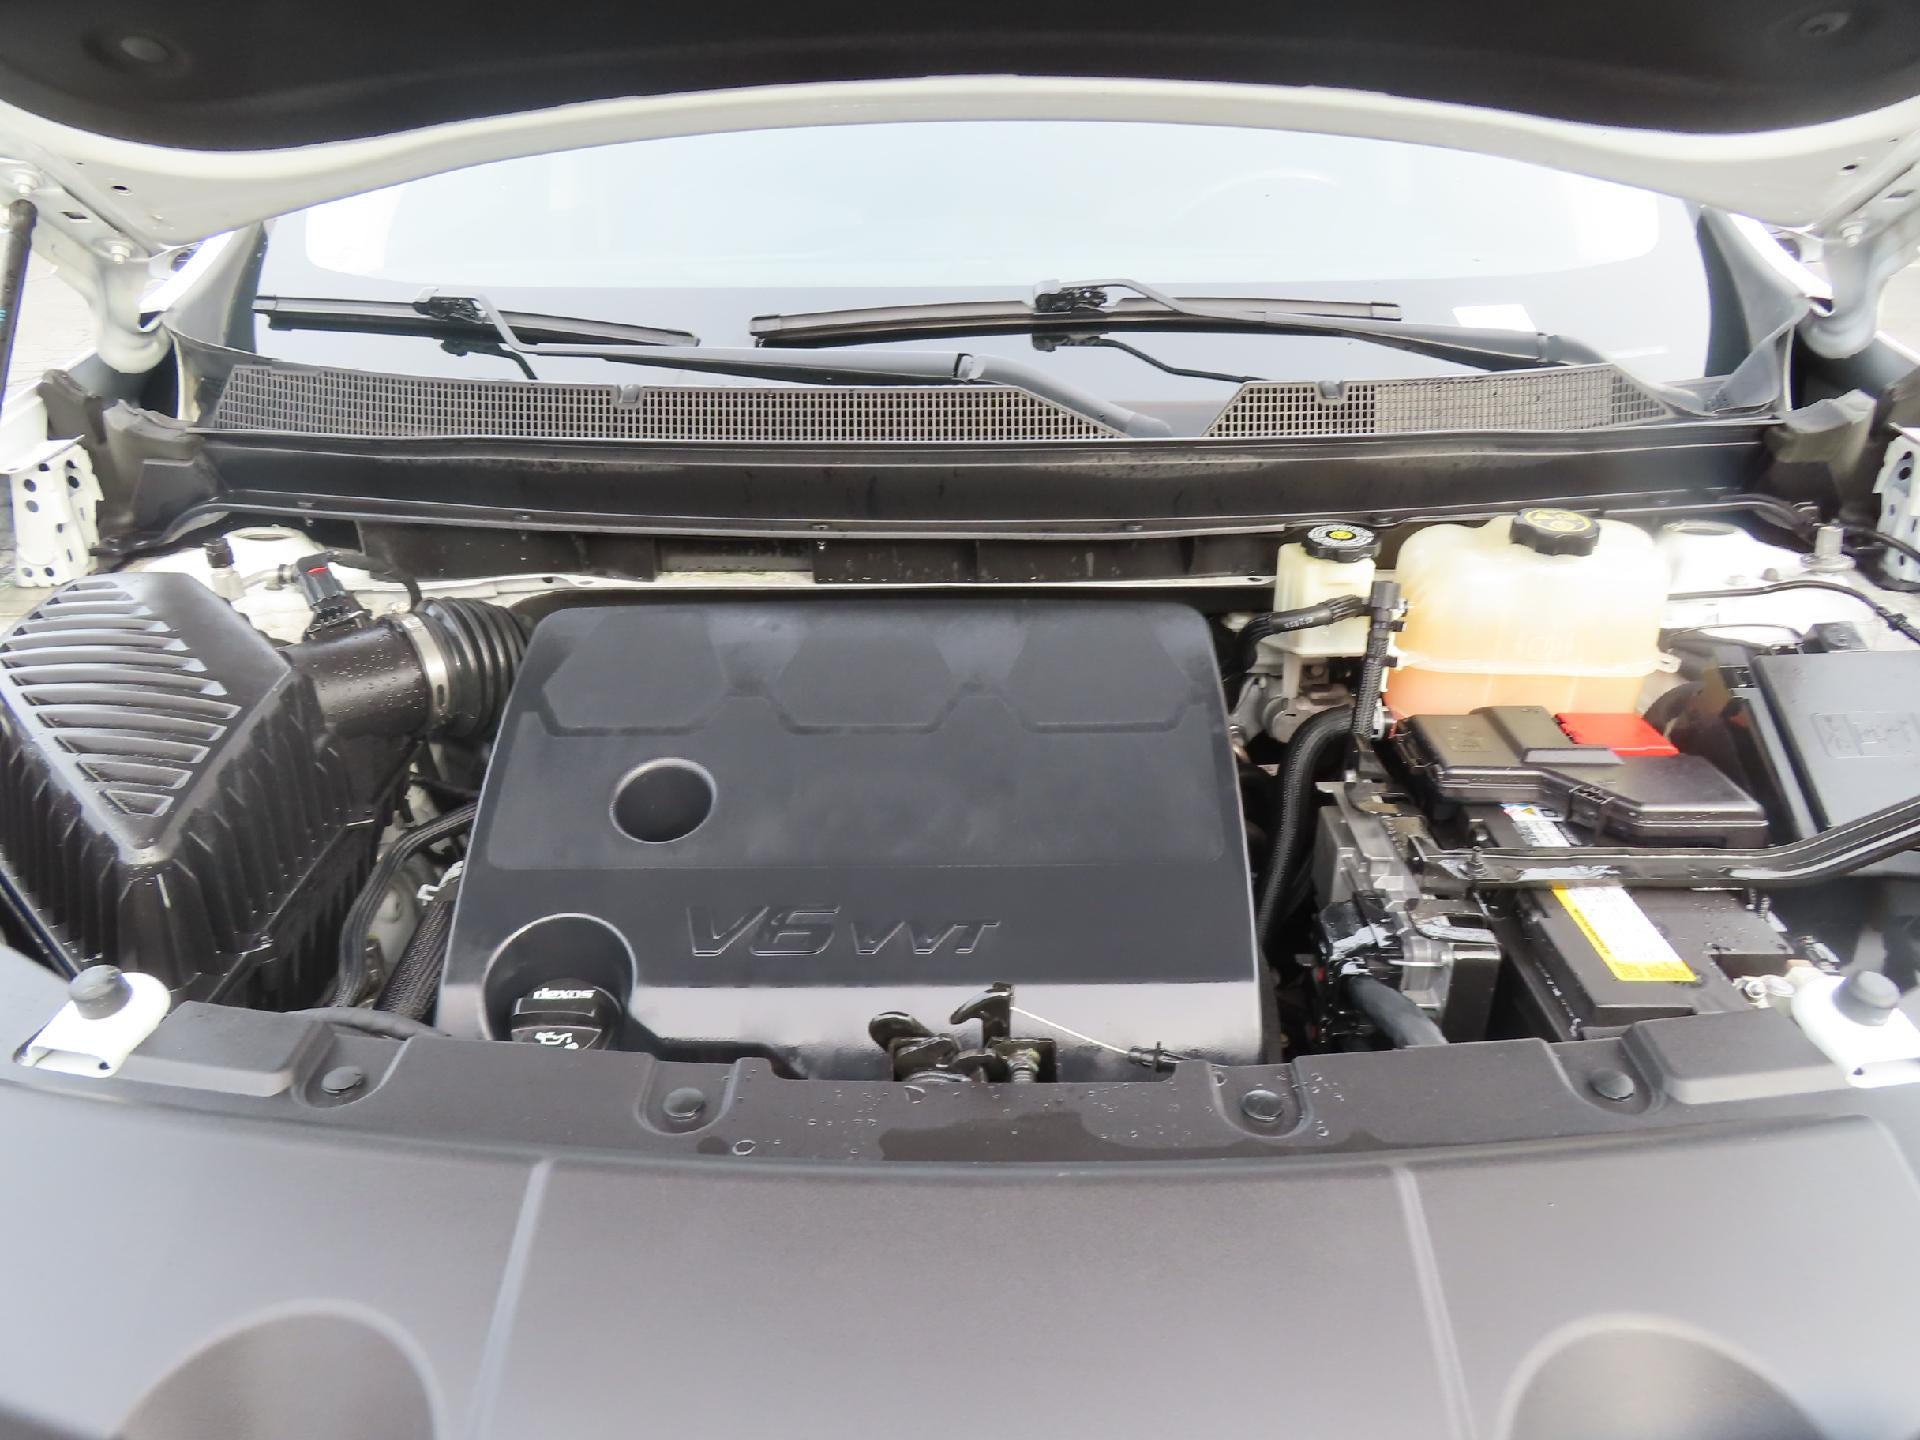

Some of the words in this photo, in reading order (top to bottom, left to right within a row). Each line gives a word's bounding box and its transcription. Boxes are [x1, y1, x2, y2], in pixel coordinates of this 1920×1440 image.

[686, 904, 839, 957] V6
[850, 919, 1001, 955] VVT
[533, 987, 596, 1000] dexos
